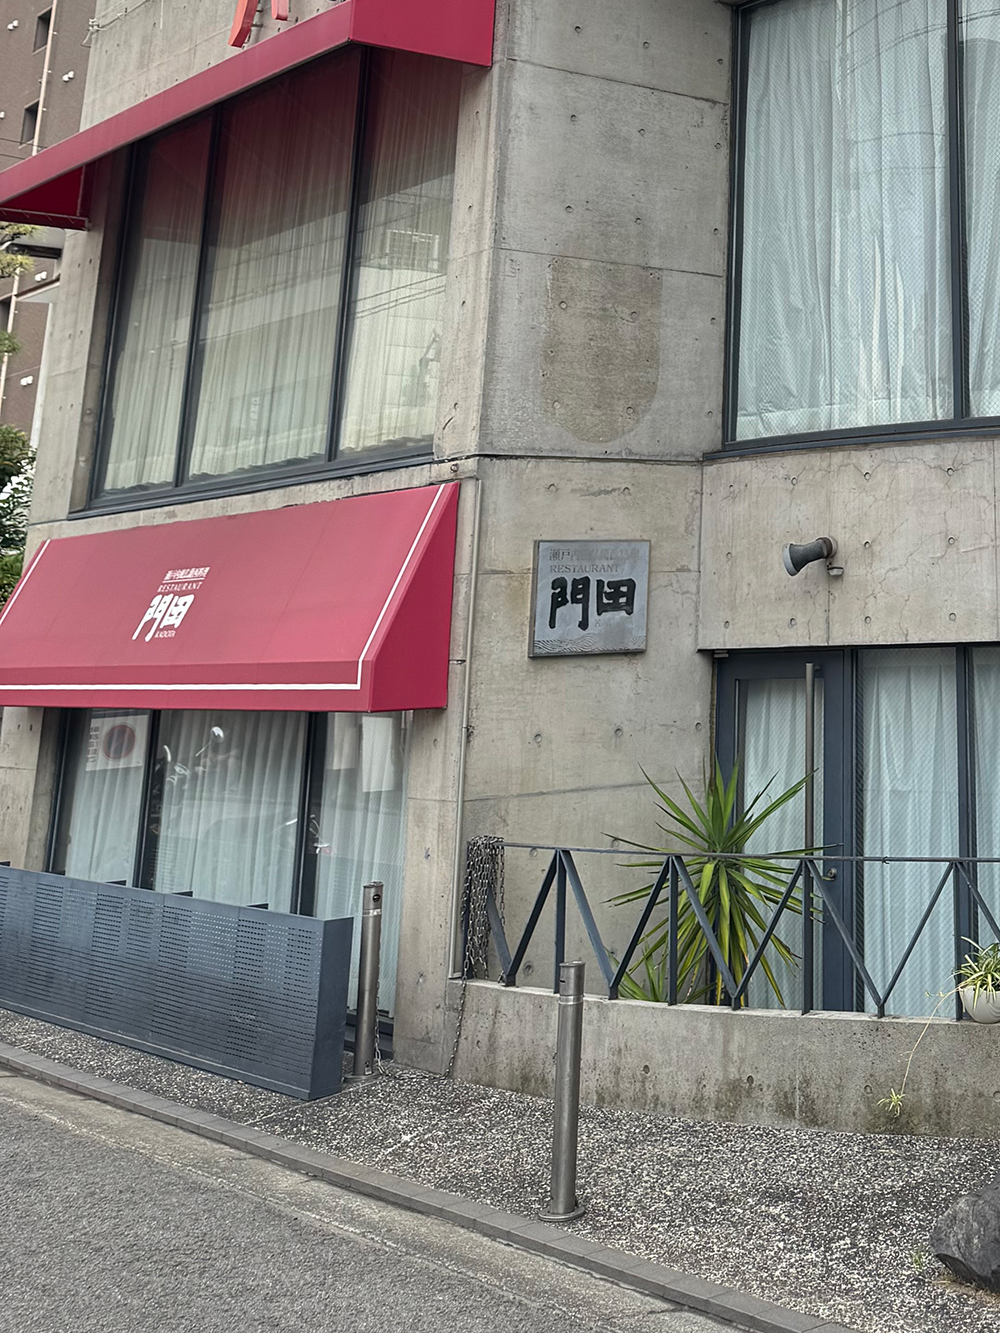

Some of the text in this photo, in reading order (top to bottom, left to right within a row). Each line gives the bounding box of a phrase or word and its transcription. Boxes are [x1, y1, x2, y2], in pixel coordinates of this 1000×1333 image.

[549, 564, 621, 573] RESTAURANT
[157, 582, 203, 592] RESTAURANT
[131, 593, 195, 643] 門田
[548, 575, 637, 631] 門田
